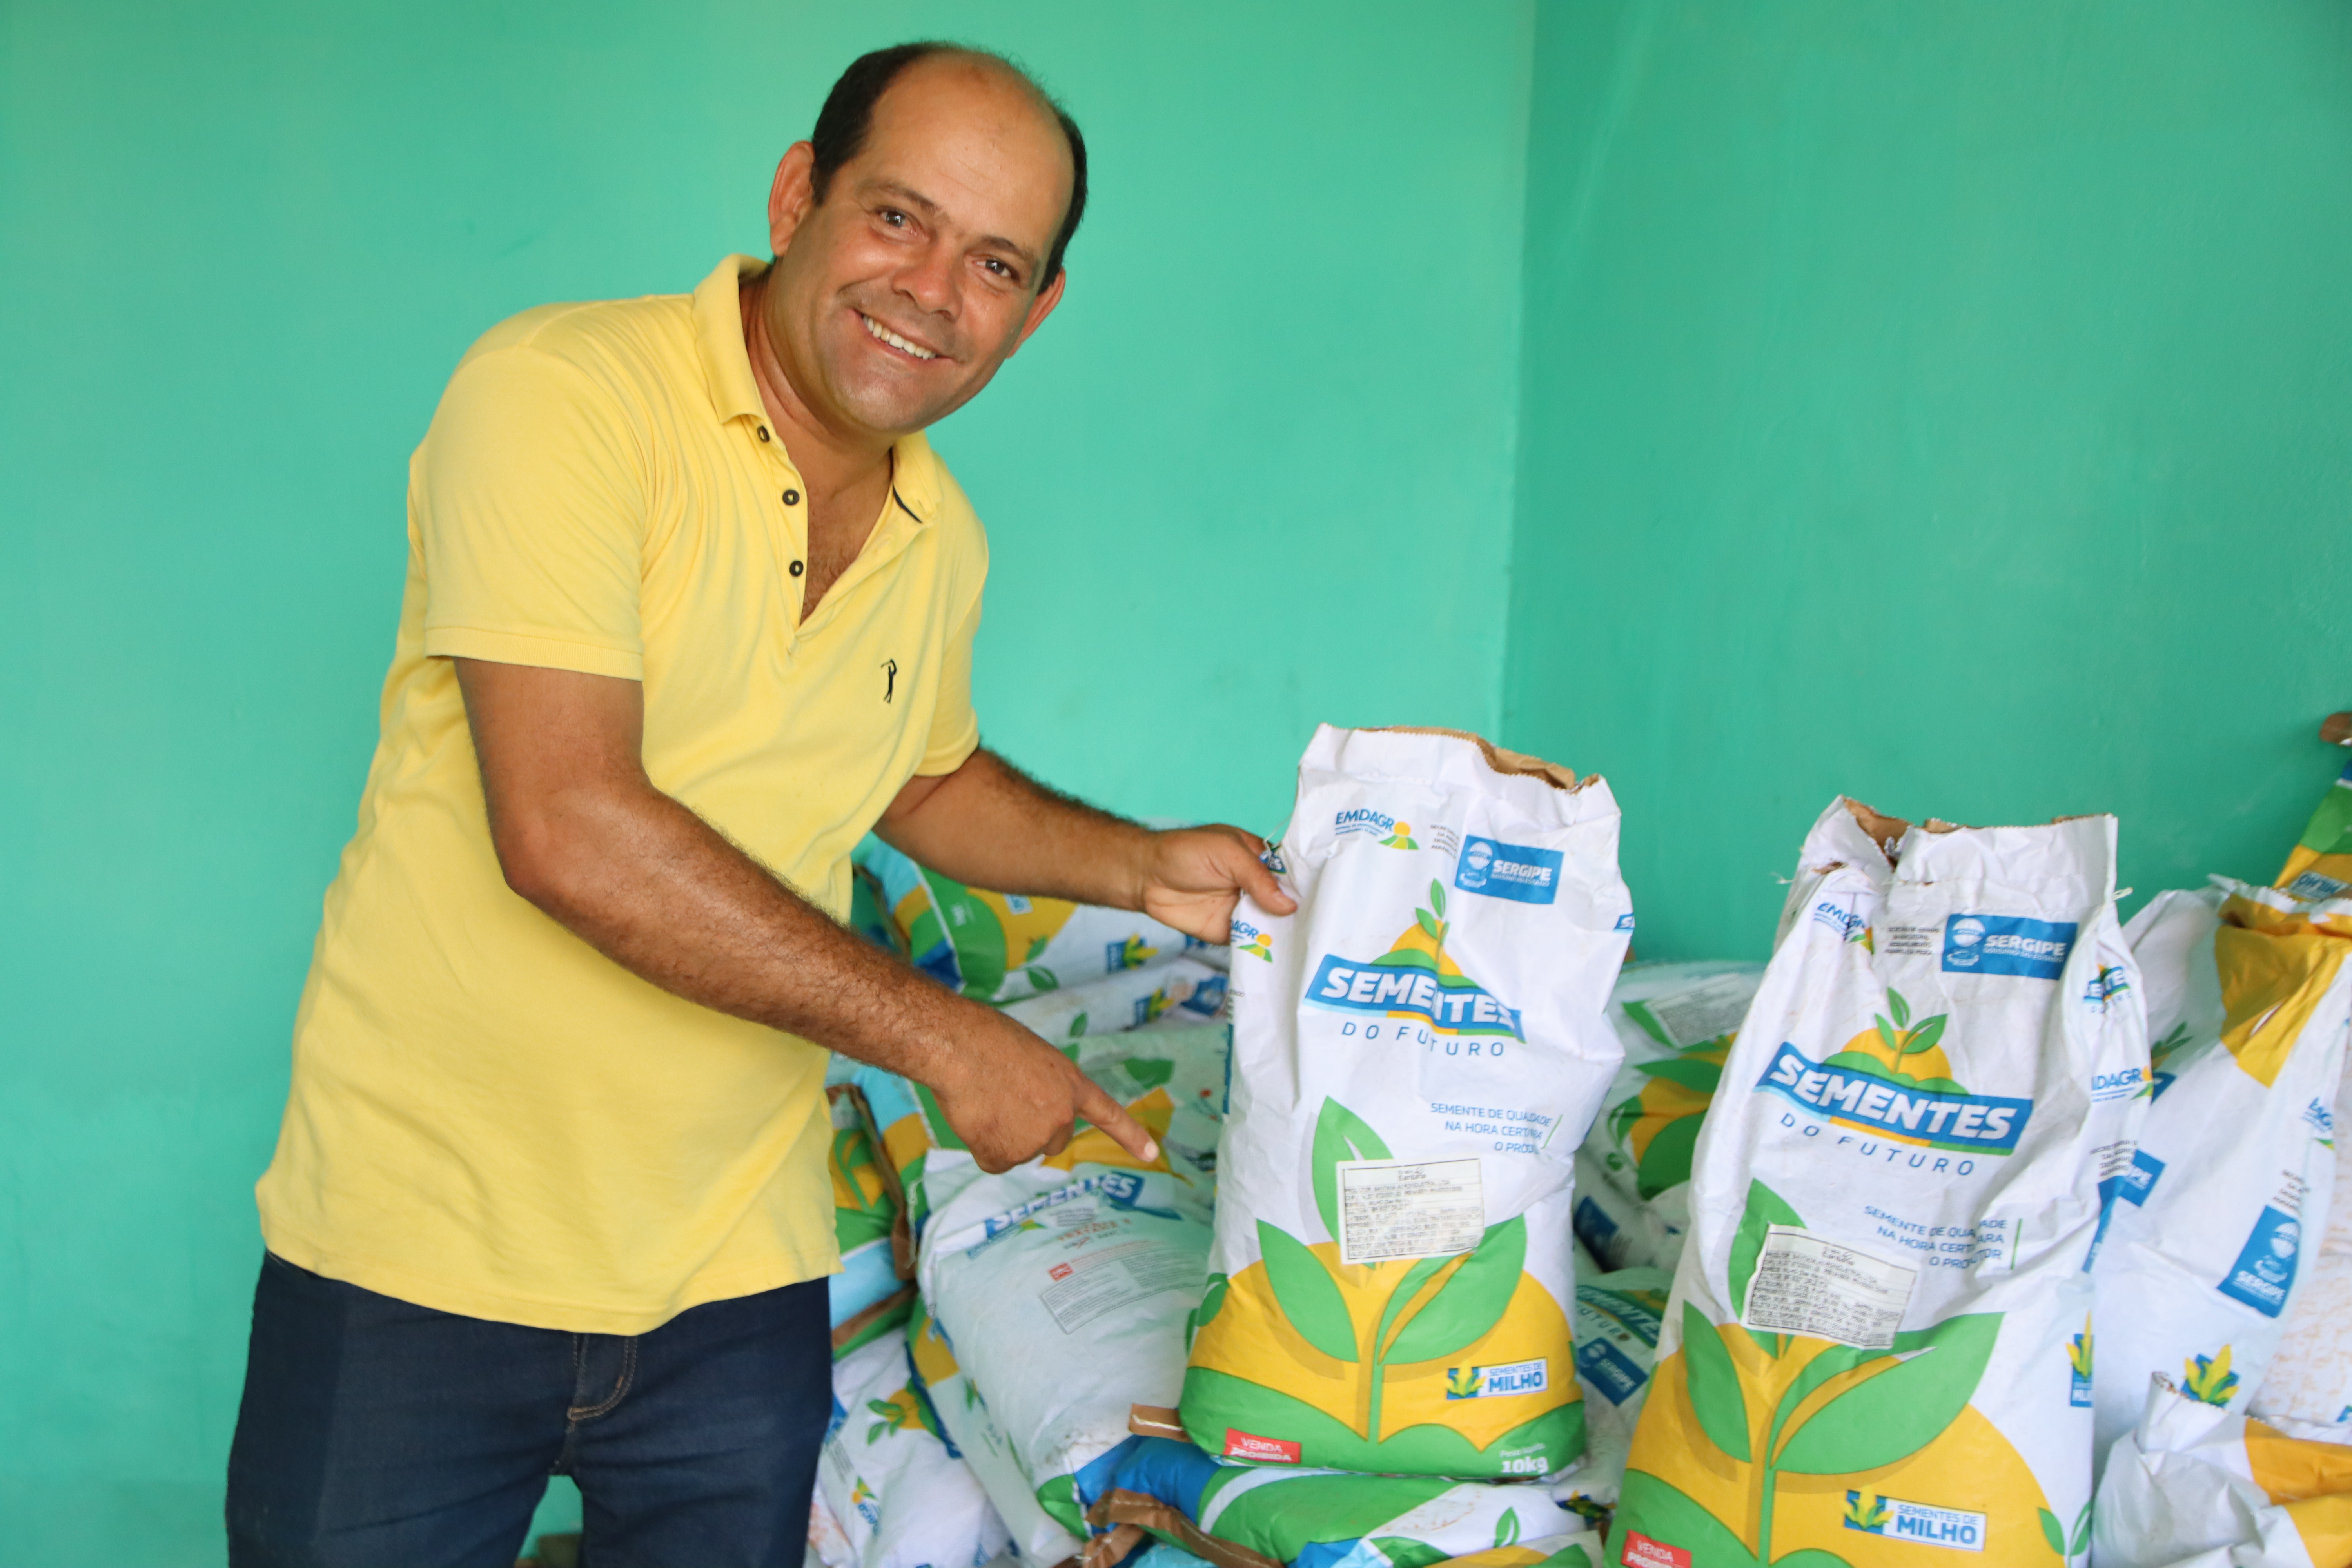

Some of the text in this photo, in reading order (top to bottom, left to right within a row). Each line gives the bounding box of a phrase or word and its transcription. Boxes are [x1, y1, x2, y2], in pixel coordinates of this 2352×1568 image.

[1493, 860, 1553, 881] SERGIPE
[1984, 935, 2067, 956] SERGIPE
[1341, 1022, 1504, 1056] DO FUTURO
[1769, 1054, 2018, 1140] SEMENTES
[1431, 1103, 1486, 1117] SEMENTE
[1489, 1109, 1504, 1118] DE
[1446, 1120, 1462, 1132] NA
[1466, 1123, 1499, 1135] HORA
[1494, 1142, 1504, 1151] O
[1780, 1112, 1975, 1176] DO FUTURO
[1864, 1205, 1927, 1235] SEMENTE
[1929, 1227, 1947, 1236] DE
[1877, 1226, 1896, 1240] NA
[1899, 1235, 1936, 1251] HORA
[1929, 1256, 1940, 1266] O
[1490, 1361, 1544, 1376] SEMENTES DE
[1489, 1371, 1542, 1392] MILHO
[1241, 1437, 1283, 1452] VENDA
[1501, 1456, 1549, 1474] 10kg
[1898, 1505, 1980, 1525] SEMENTES DE
[1898, 1515, 1976, 1544] MILHO
